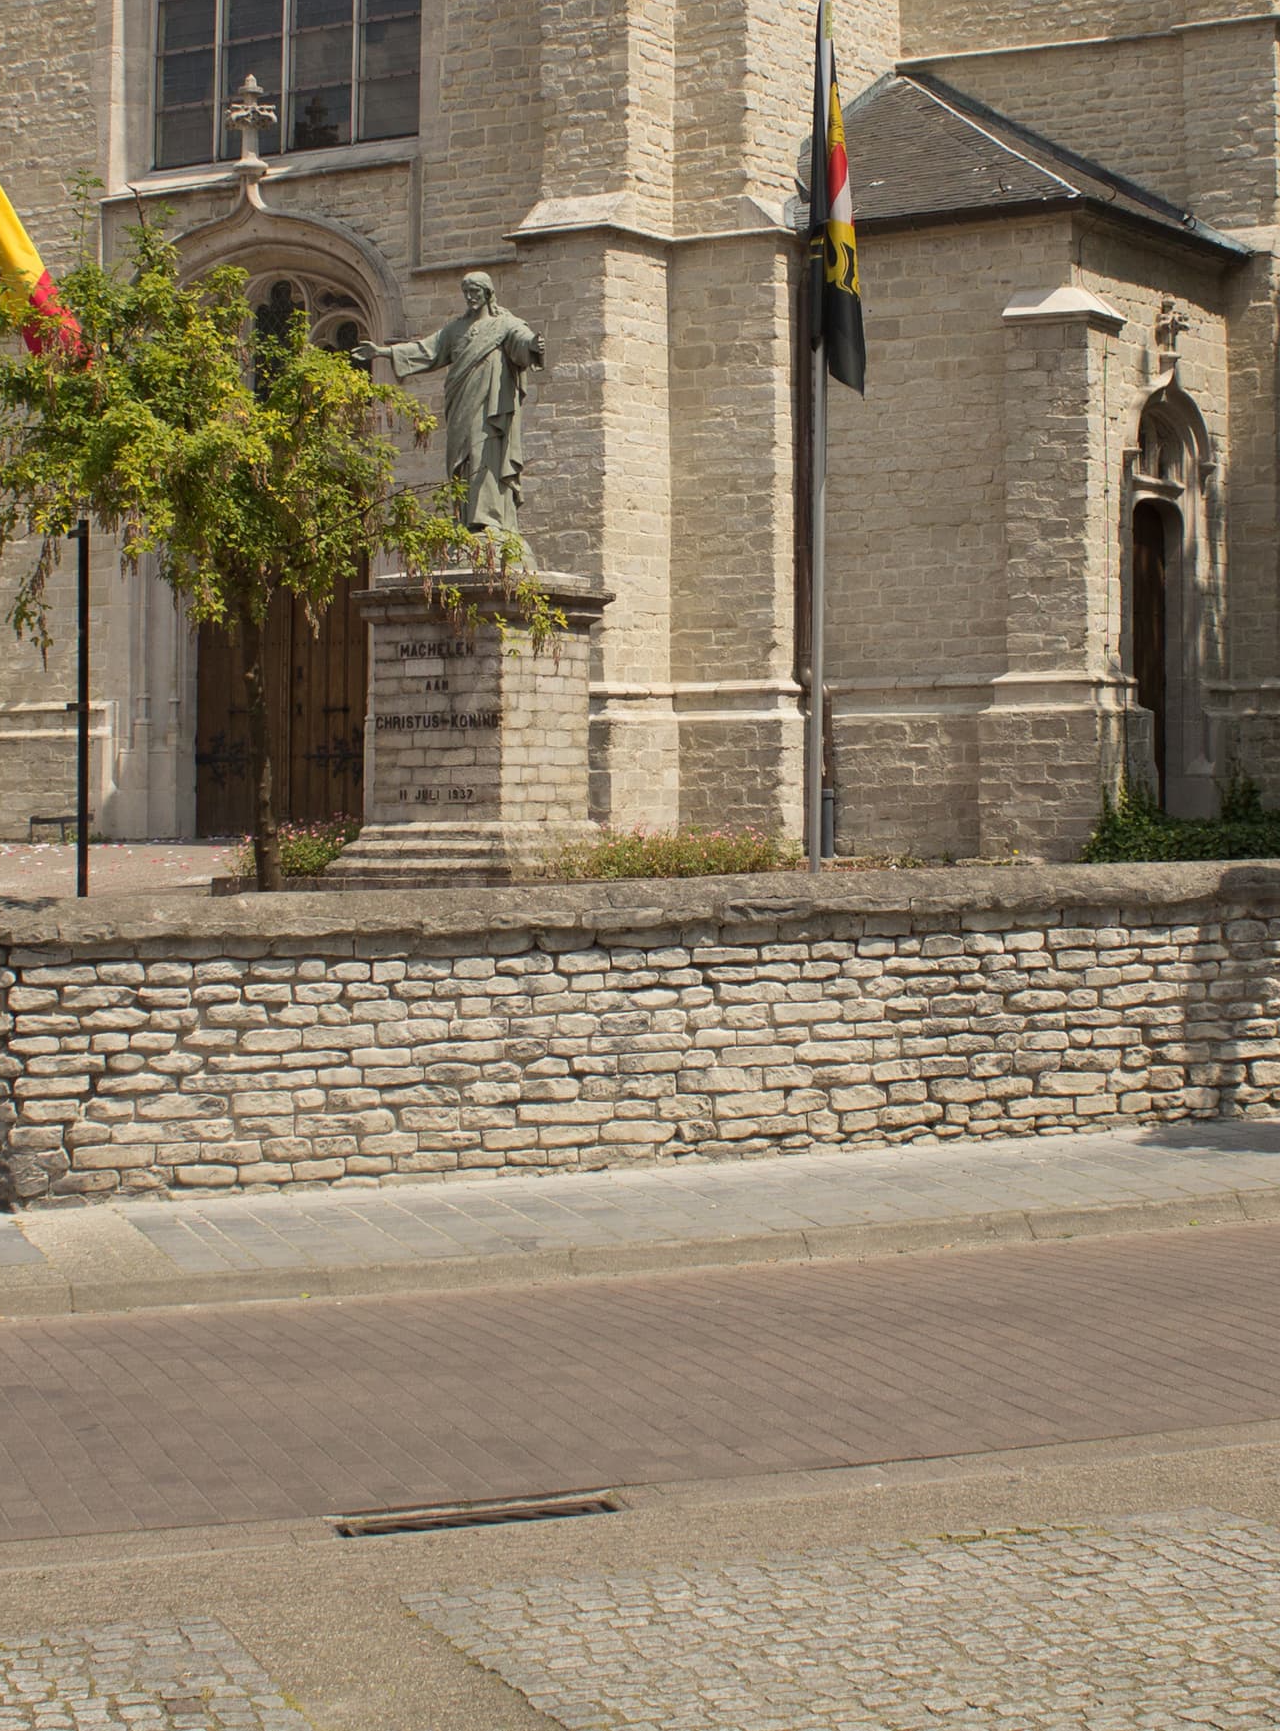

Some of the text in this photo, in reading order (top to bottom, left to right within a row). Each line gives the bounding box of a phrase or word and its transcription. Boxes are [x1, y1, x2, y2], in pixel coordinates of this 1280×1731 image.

[399, 641, 474, 657] MACHELEN
[425, 680, 449, 691] AAN
[375, 713, 499, 730] CHRISTUS-KONING
[415, 789, 440, 801] JULI
[448, 789, 473, 800] 1937
